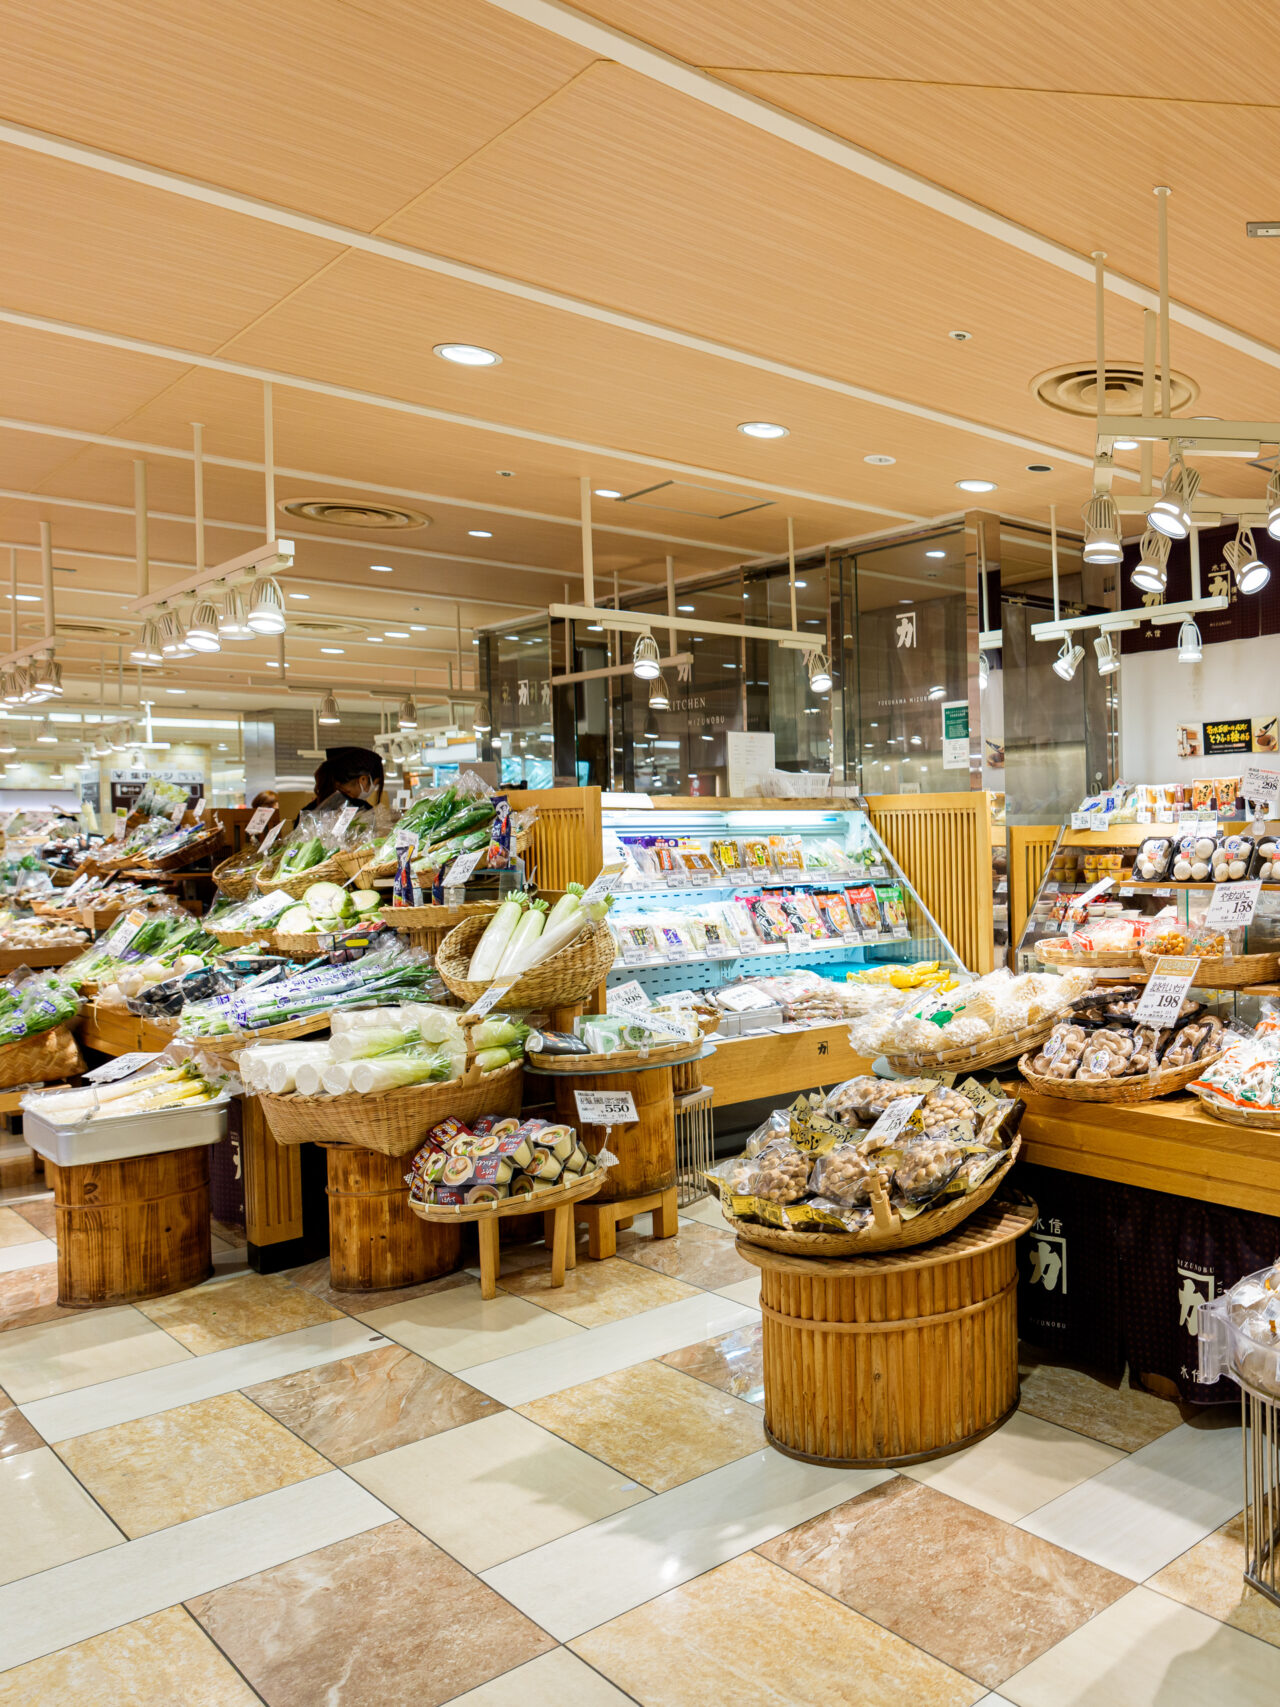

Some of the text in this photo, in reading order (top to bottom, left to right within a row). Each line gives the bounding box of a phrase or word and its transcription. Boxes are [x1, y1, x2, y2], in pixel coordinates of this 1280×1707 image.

[1145, 629, 1161, 638] 水信
[667, 697, 706, 712] KITCHEN
[1232, 900, 1254, 914] 158
[1155, 994, 1181, 1009] 198
[605, 1103, 630, 1113] 550
[1033, 1217, 1063, 1235] 水信
[1029, 1241, 1063, 1292] 力
